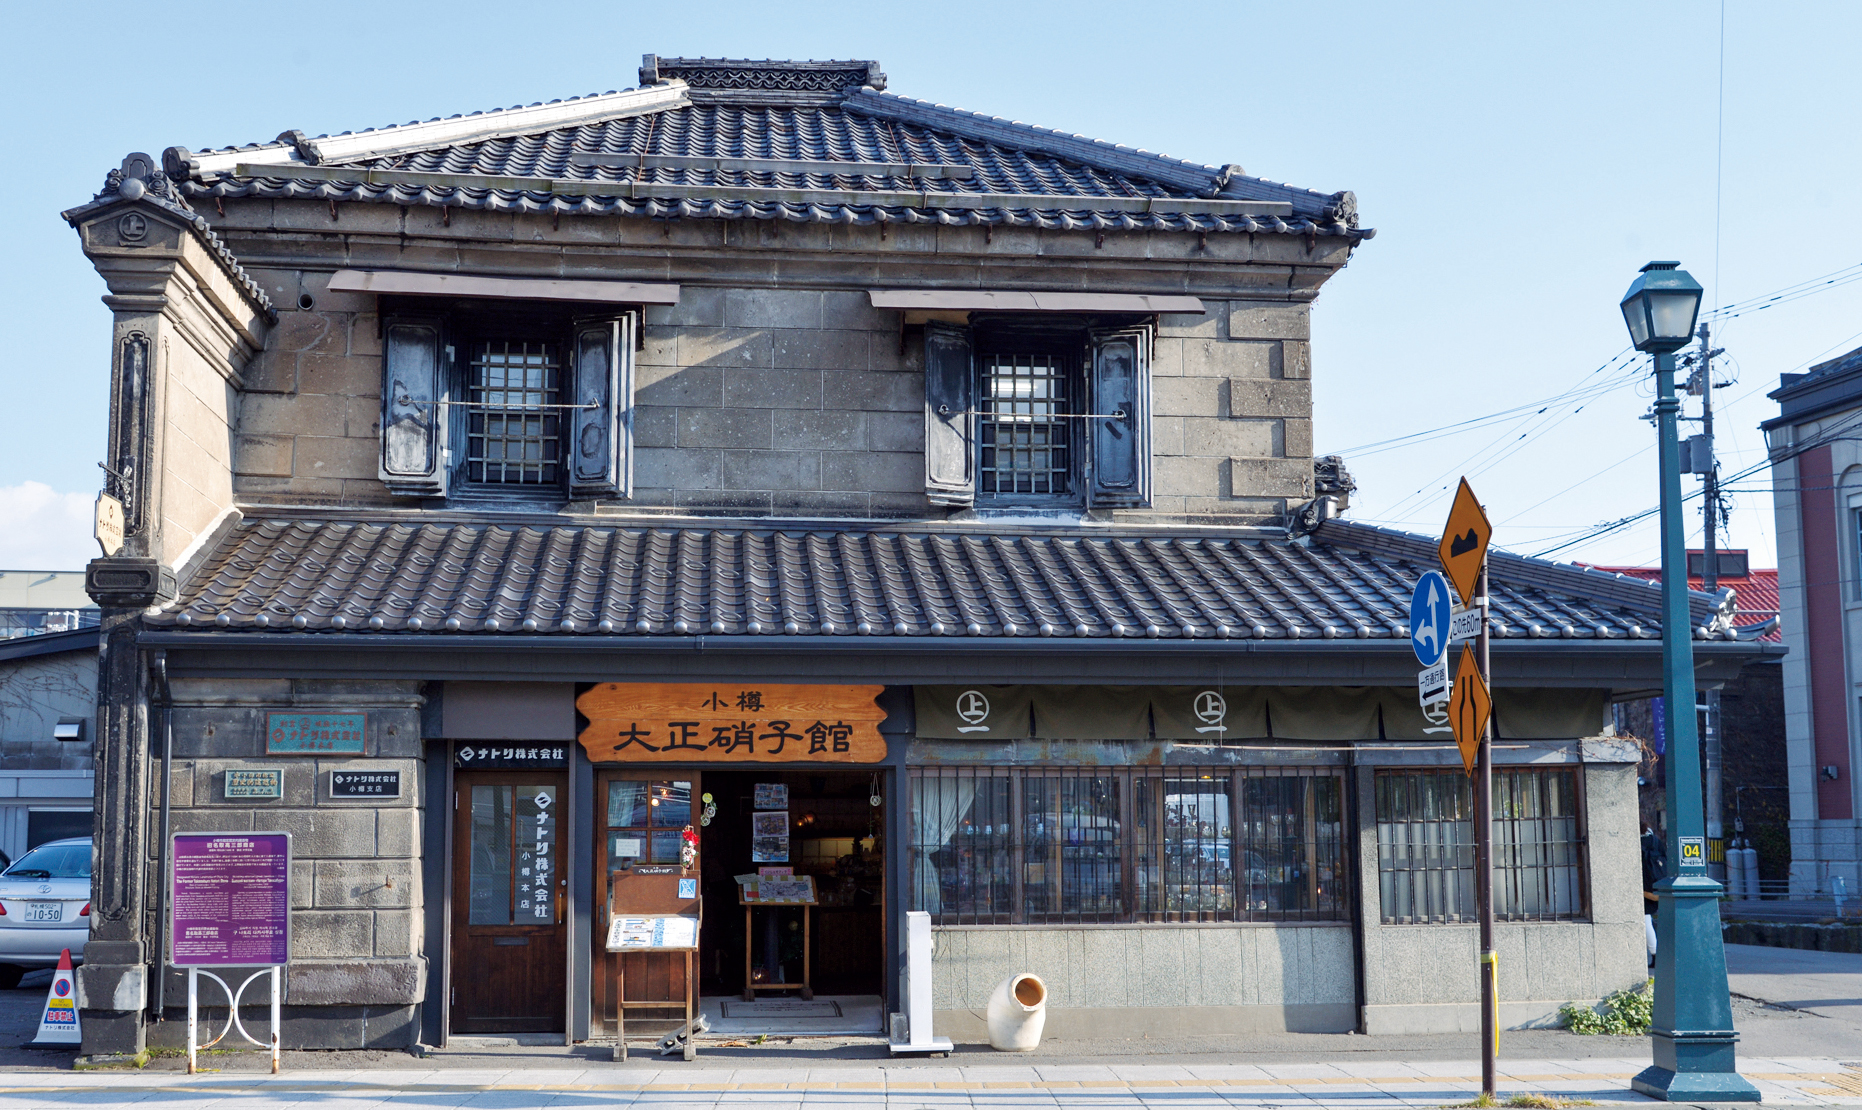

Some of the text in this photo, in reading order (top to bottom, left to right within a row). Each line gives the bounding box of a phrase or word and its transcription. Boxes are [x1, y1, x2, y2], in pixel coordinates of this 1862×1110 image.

[1452, 614, 1481, 636] この先60m
[702, 691, 765, 712] 小樽
[290, 730, 361, 741] ナトリ株式会社
[613, 720, 853, 754] 大正硝子館
[478, 748, 563, 760] ナトリ株式会社
[346, 775, 397, 783] ナトリ株式会社
[349, 785, 383, 793] 小樽支店
[1683, 844, 1700, 857] 04
[534, 811, 549, 918] ナトリ株式会社
[520, 851, 531, 909] 小樽本店
[34, 909, 59, 920] 10-50
[47, 1011, 73, 1022] 駐車禁止
